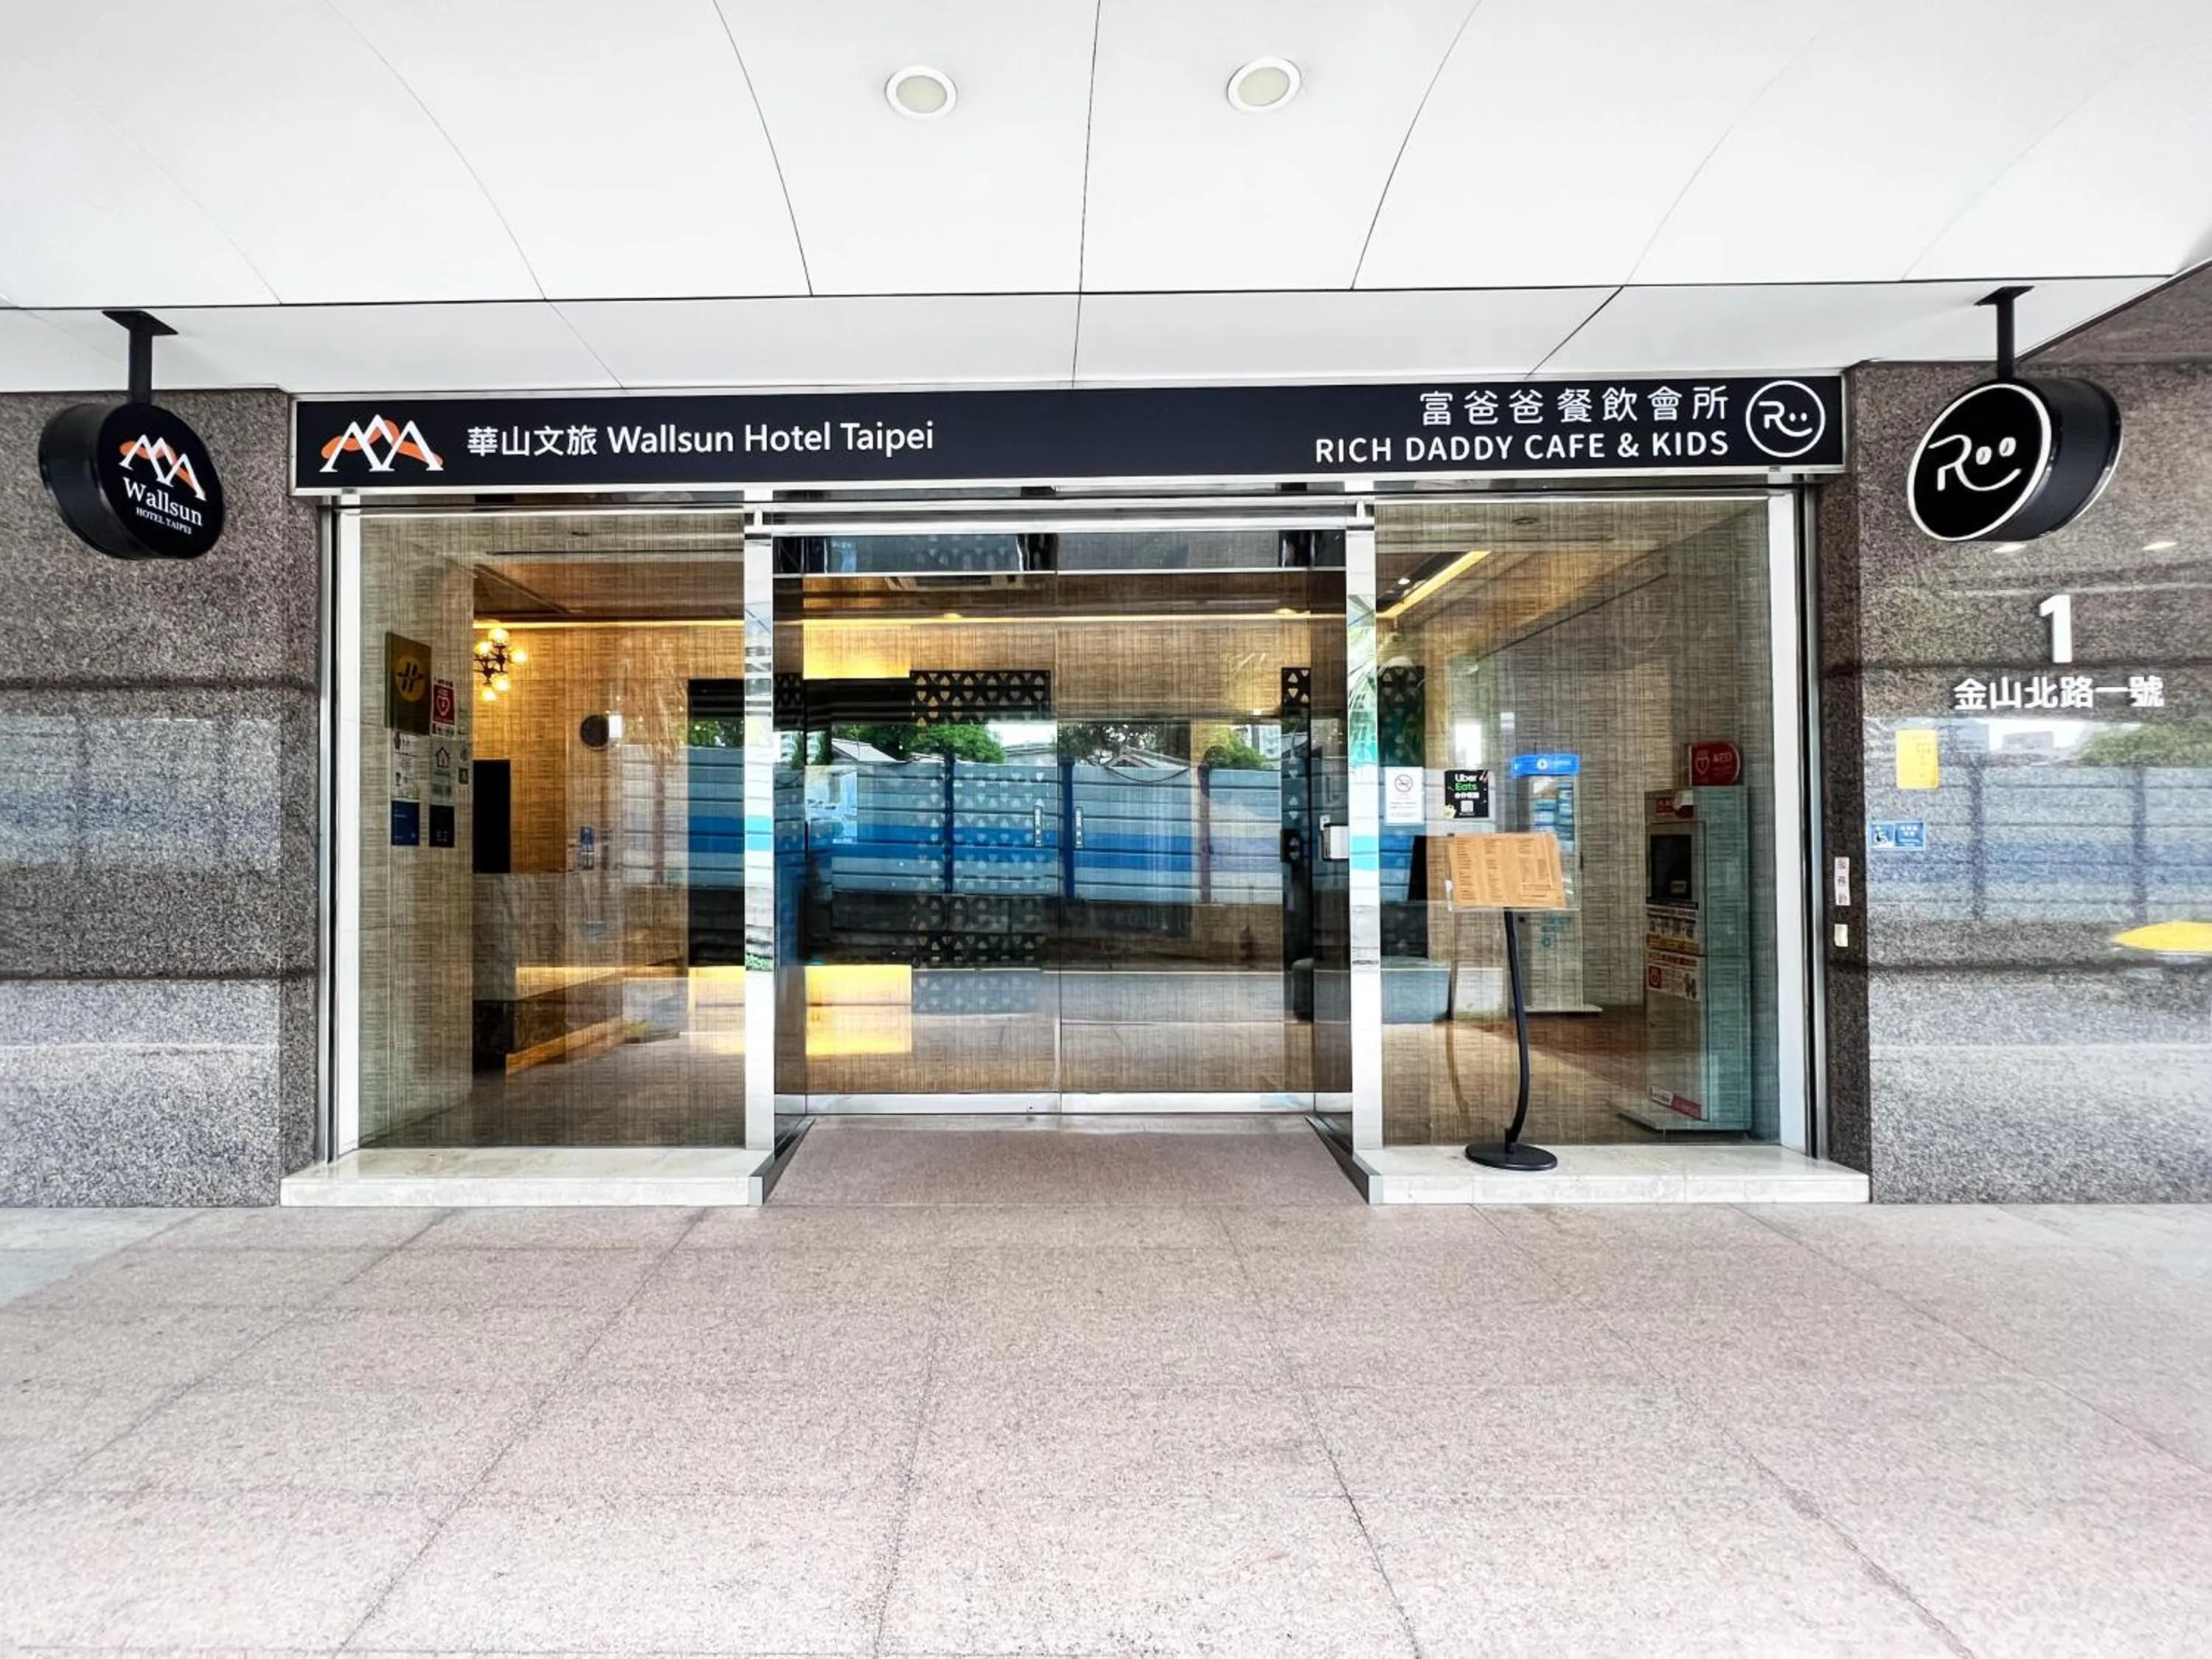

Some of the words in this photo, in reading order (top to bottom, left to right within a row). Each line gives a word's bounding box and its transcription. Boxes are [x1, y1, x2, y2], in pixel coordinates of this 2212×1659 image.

[1419, 386, 1729, 425] 富爸爸餐飲會所
[467, 425, 597, 456] 華山文旅
[607, 424, 733, 453] Wallsun
[745, 421, 831, 451] Hotel
[840, 420, 933, 458] Taipei
[1315, 437, 1391, 463] RICH
[1406, 435, 1513, 461] DADDY
[1525, 433, 1605, 459] CAFE
[1616, 432, 1640, 458] &
[1652, 430, 1729, 457] KIDS
[122, 476, 203, 526] Wallsun
[136, 507, 164, 524] HOTEL
[166, 518, 192, 535] TAIPEI
[2039, 594, 2073, 663] 1
[1954, 675, 2164, 709] 金山北路一號
[1712, 751, 1732, 762] AED
[1455, 773, 1477, 782] Uber
[1455, 782, 1478, 790] Eats
